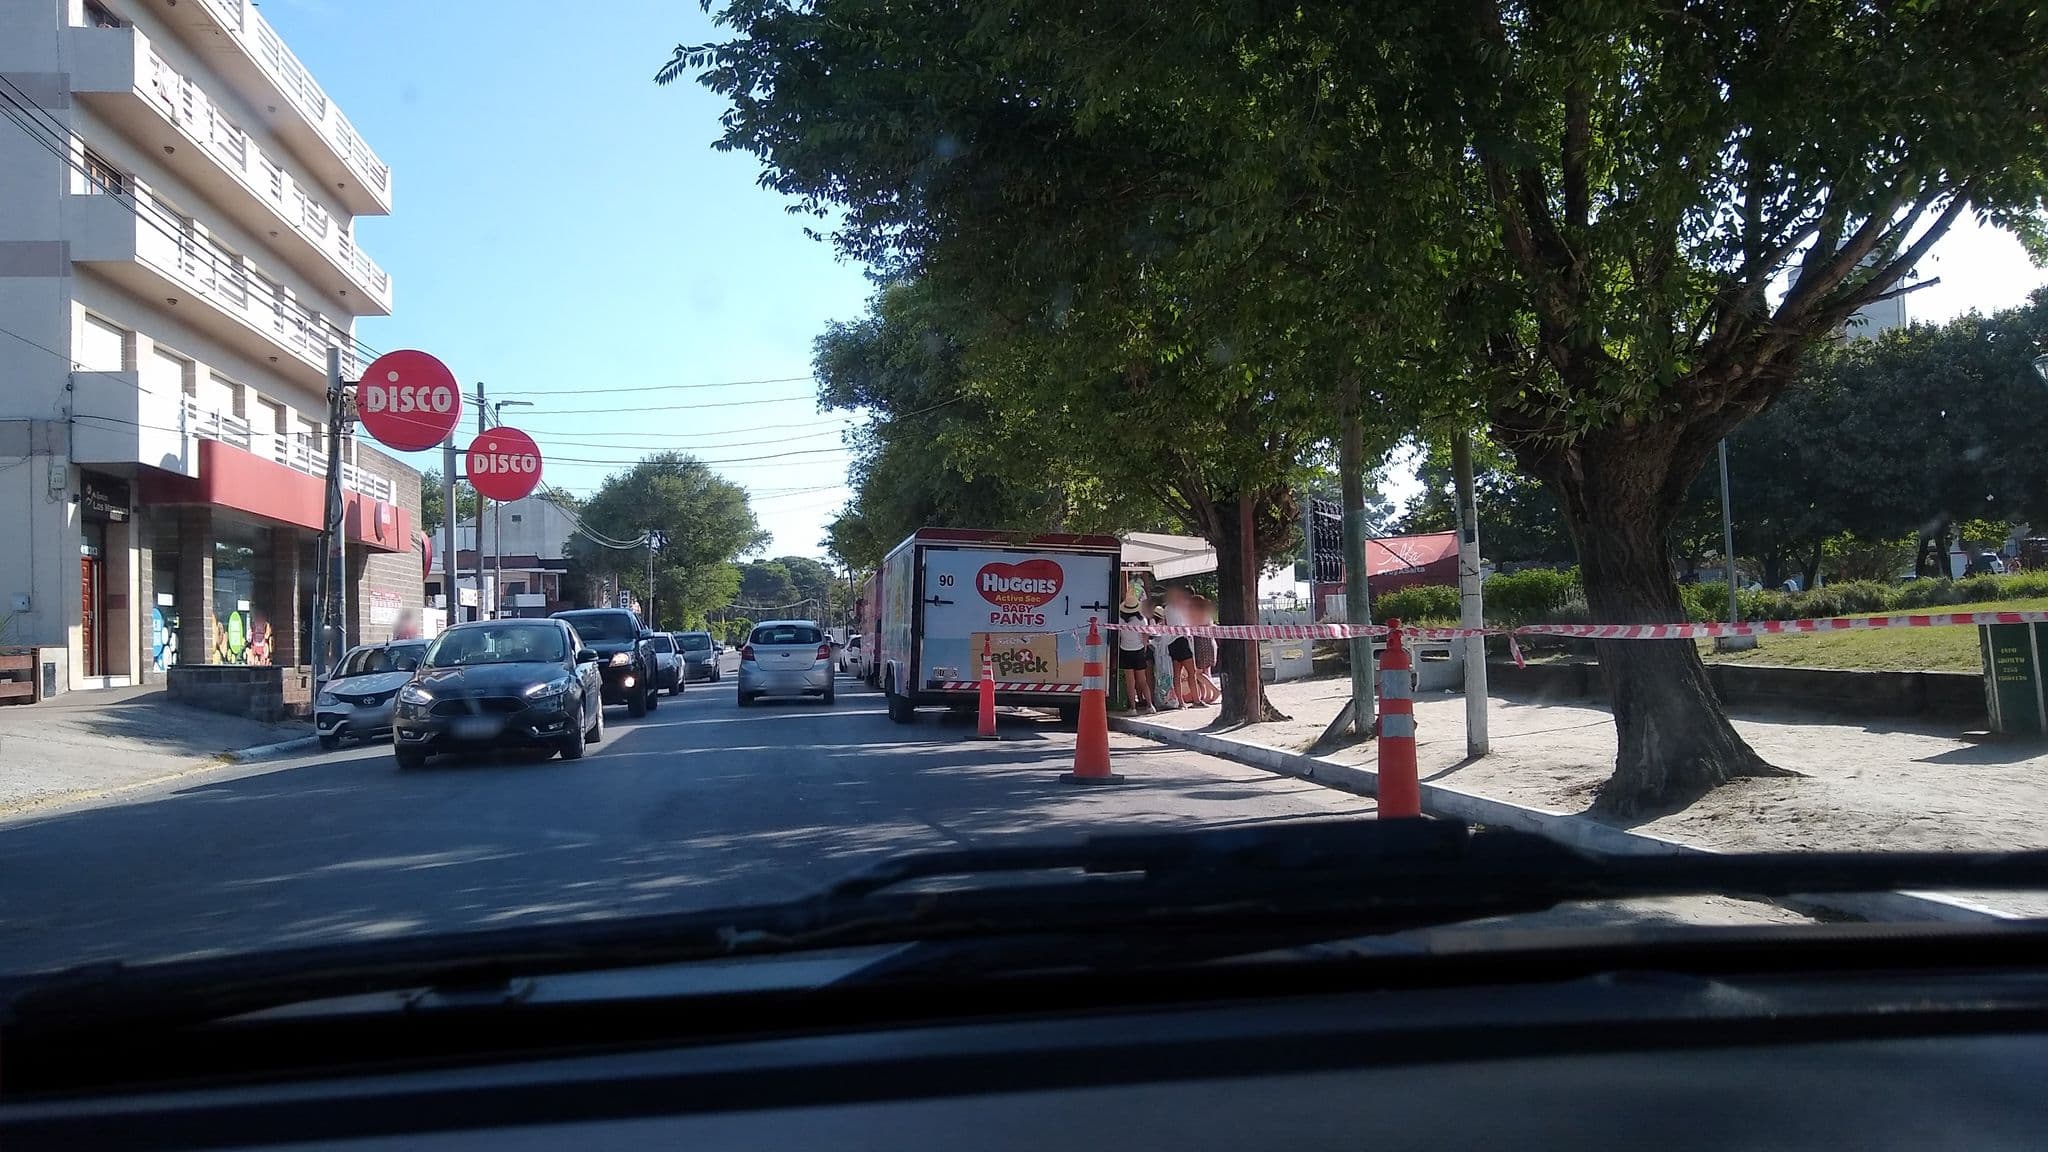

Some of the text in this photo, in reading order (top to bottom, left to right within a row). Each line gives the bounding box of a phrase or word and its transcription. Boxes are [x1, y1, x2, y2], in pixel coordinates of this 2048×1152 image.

[939, 575, 955, 587] 90
[1003, 604, 1033, 613] BABY
[990, 612, 1046, 626] PANTS
